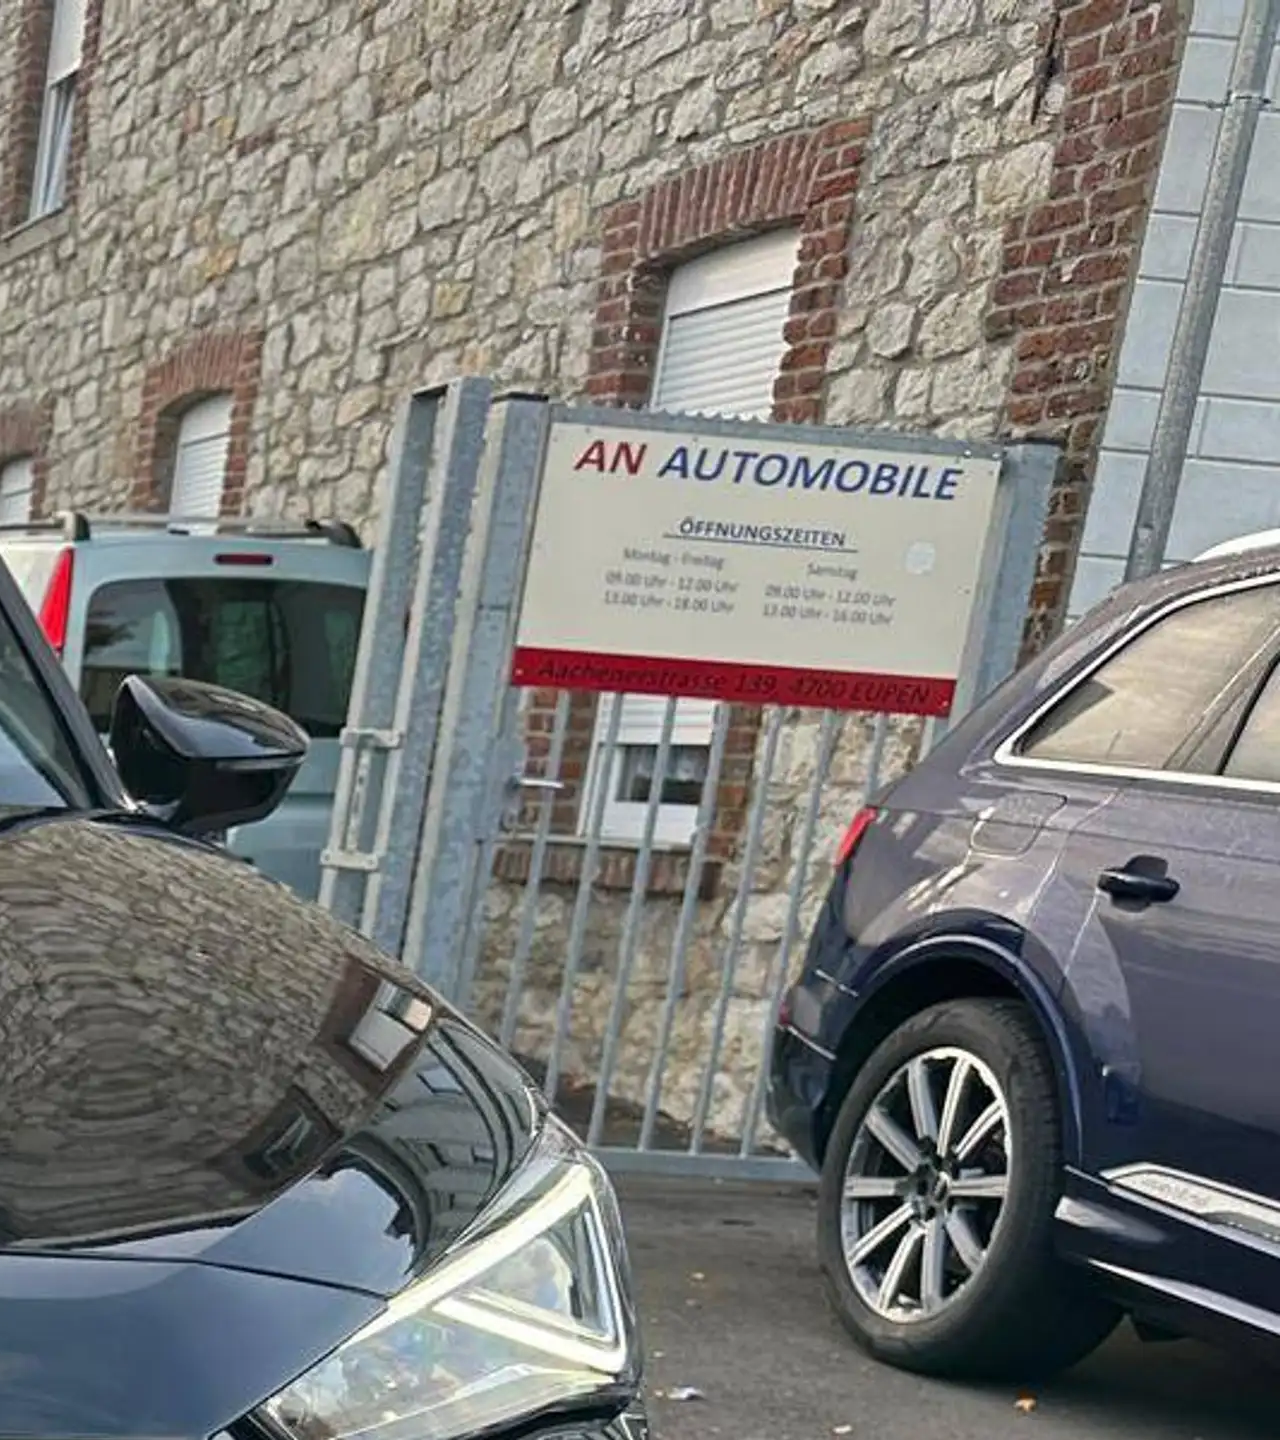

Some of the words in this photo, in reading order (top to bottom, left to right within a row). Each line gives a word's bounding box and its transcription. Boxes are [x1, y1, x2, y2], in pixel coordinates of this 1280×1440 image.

[574, 439, 647, 476] AN
[658, 446, 963, 501] AUTOMOBILE
[679, 516, 845, 547] ÖFFNUNGSZEITEN
[538, 658, 726, 692] Aachenerstrasse
[849, 681, 932, 705] EUPEN
